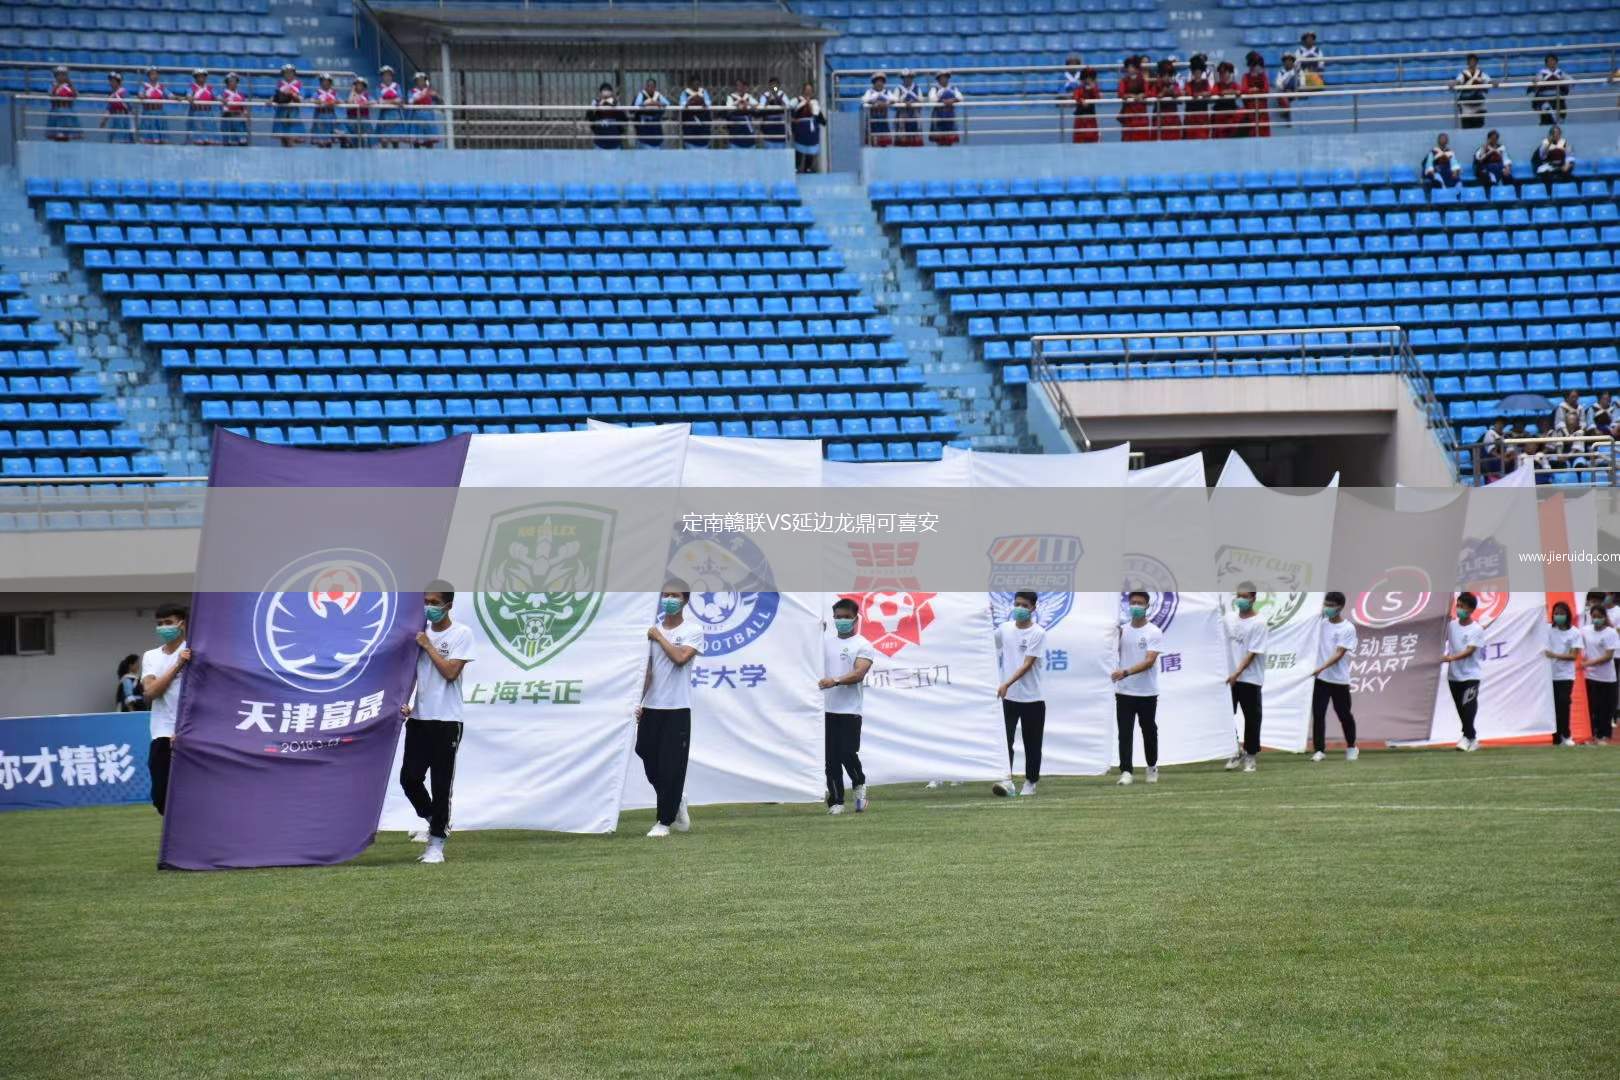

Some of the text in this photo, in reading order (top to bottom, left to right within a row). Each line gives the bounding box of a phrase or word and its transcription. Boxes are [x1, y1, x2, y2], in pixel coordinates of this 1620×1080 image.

[848, 542, 919, 566] 359
[1456, 553, 1501, 575] TURE
[993, 575, 1069, 587] DEEHERO
[702, 611, 771, 653] OOTBALL
[690, 664, 767, 689] 华大学
[1349, 656, 1414, 675] MART
[463, 680, 583, 704] 上海华正
[235, 689, 385, 733] 天津富晟
